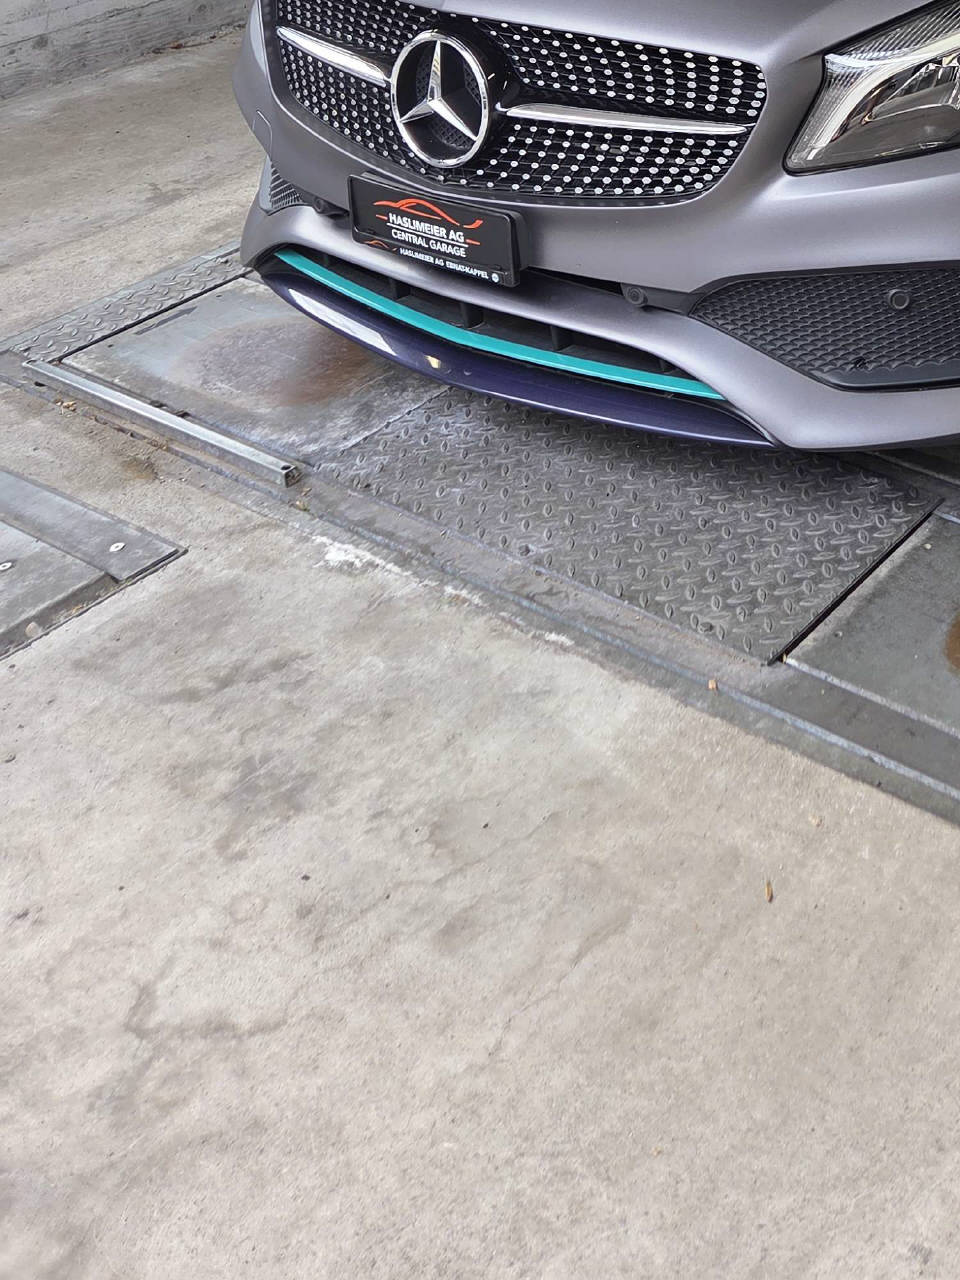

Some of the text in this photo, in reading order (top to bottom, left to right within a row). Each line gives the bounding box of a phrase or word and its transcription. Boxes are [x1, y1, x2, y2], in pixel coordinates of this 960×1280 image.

[389, 213, 465, 243] HASLIMEIER AG
[391, 229, 466, 257] CENTRAL GARAGE
[435, 258, 444, 266] AG
